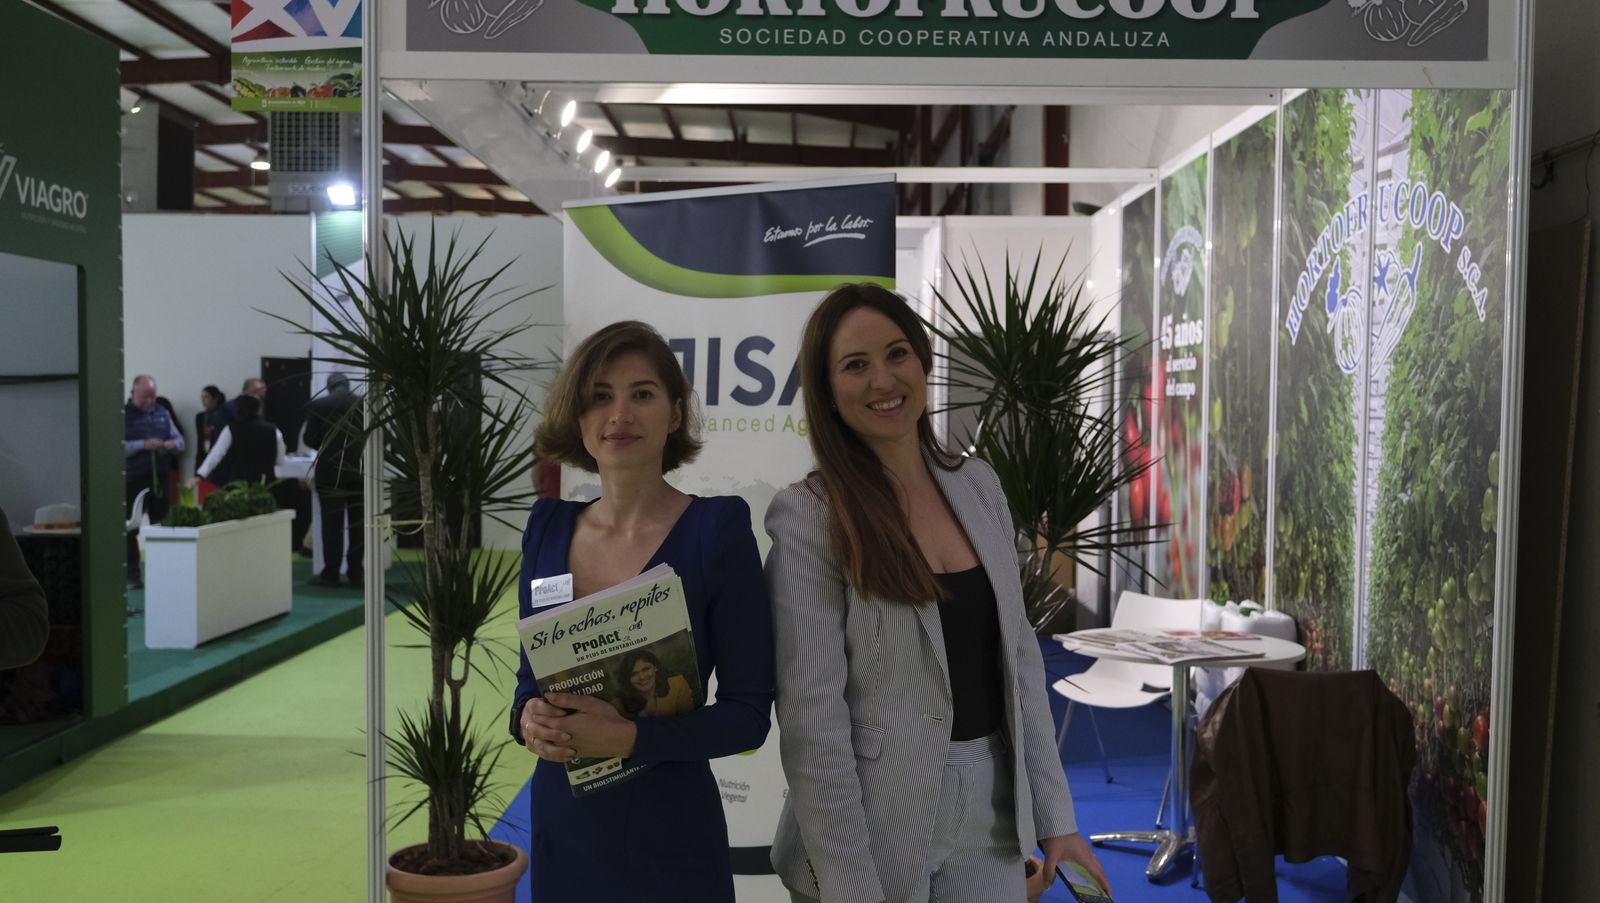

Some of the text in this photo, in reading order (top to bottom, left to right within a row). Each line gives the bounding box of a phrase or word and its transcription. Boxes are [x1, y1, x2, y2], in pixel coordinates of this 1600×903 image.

[719, 28, 1170, 47] SOCIEDAD COOPERATIVA ANDALUZA
[15, 173, 87, 219] VIAGRO
[805, 221, 824, 241] por
[1285, 178, 1464, 346] HORTOFRUCOOP
[1457, 245, 1488, 322] S.C.A.
[530, 630, 549, 651] Si
[552, 621, 565, 645] lo
[620, 583, 671, 622] repites
[572, 630, 621, 655] ProAct
[576, 636, 648, 663] UN PLUS DE RENTABILIDAD
[548, 668, 605, 692] PRODUCCIÓN
[582, 784, 593, 792] UN
[718, 778, 751, 792] Nutrición
[721, 790, 748, 804] Vegetal
